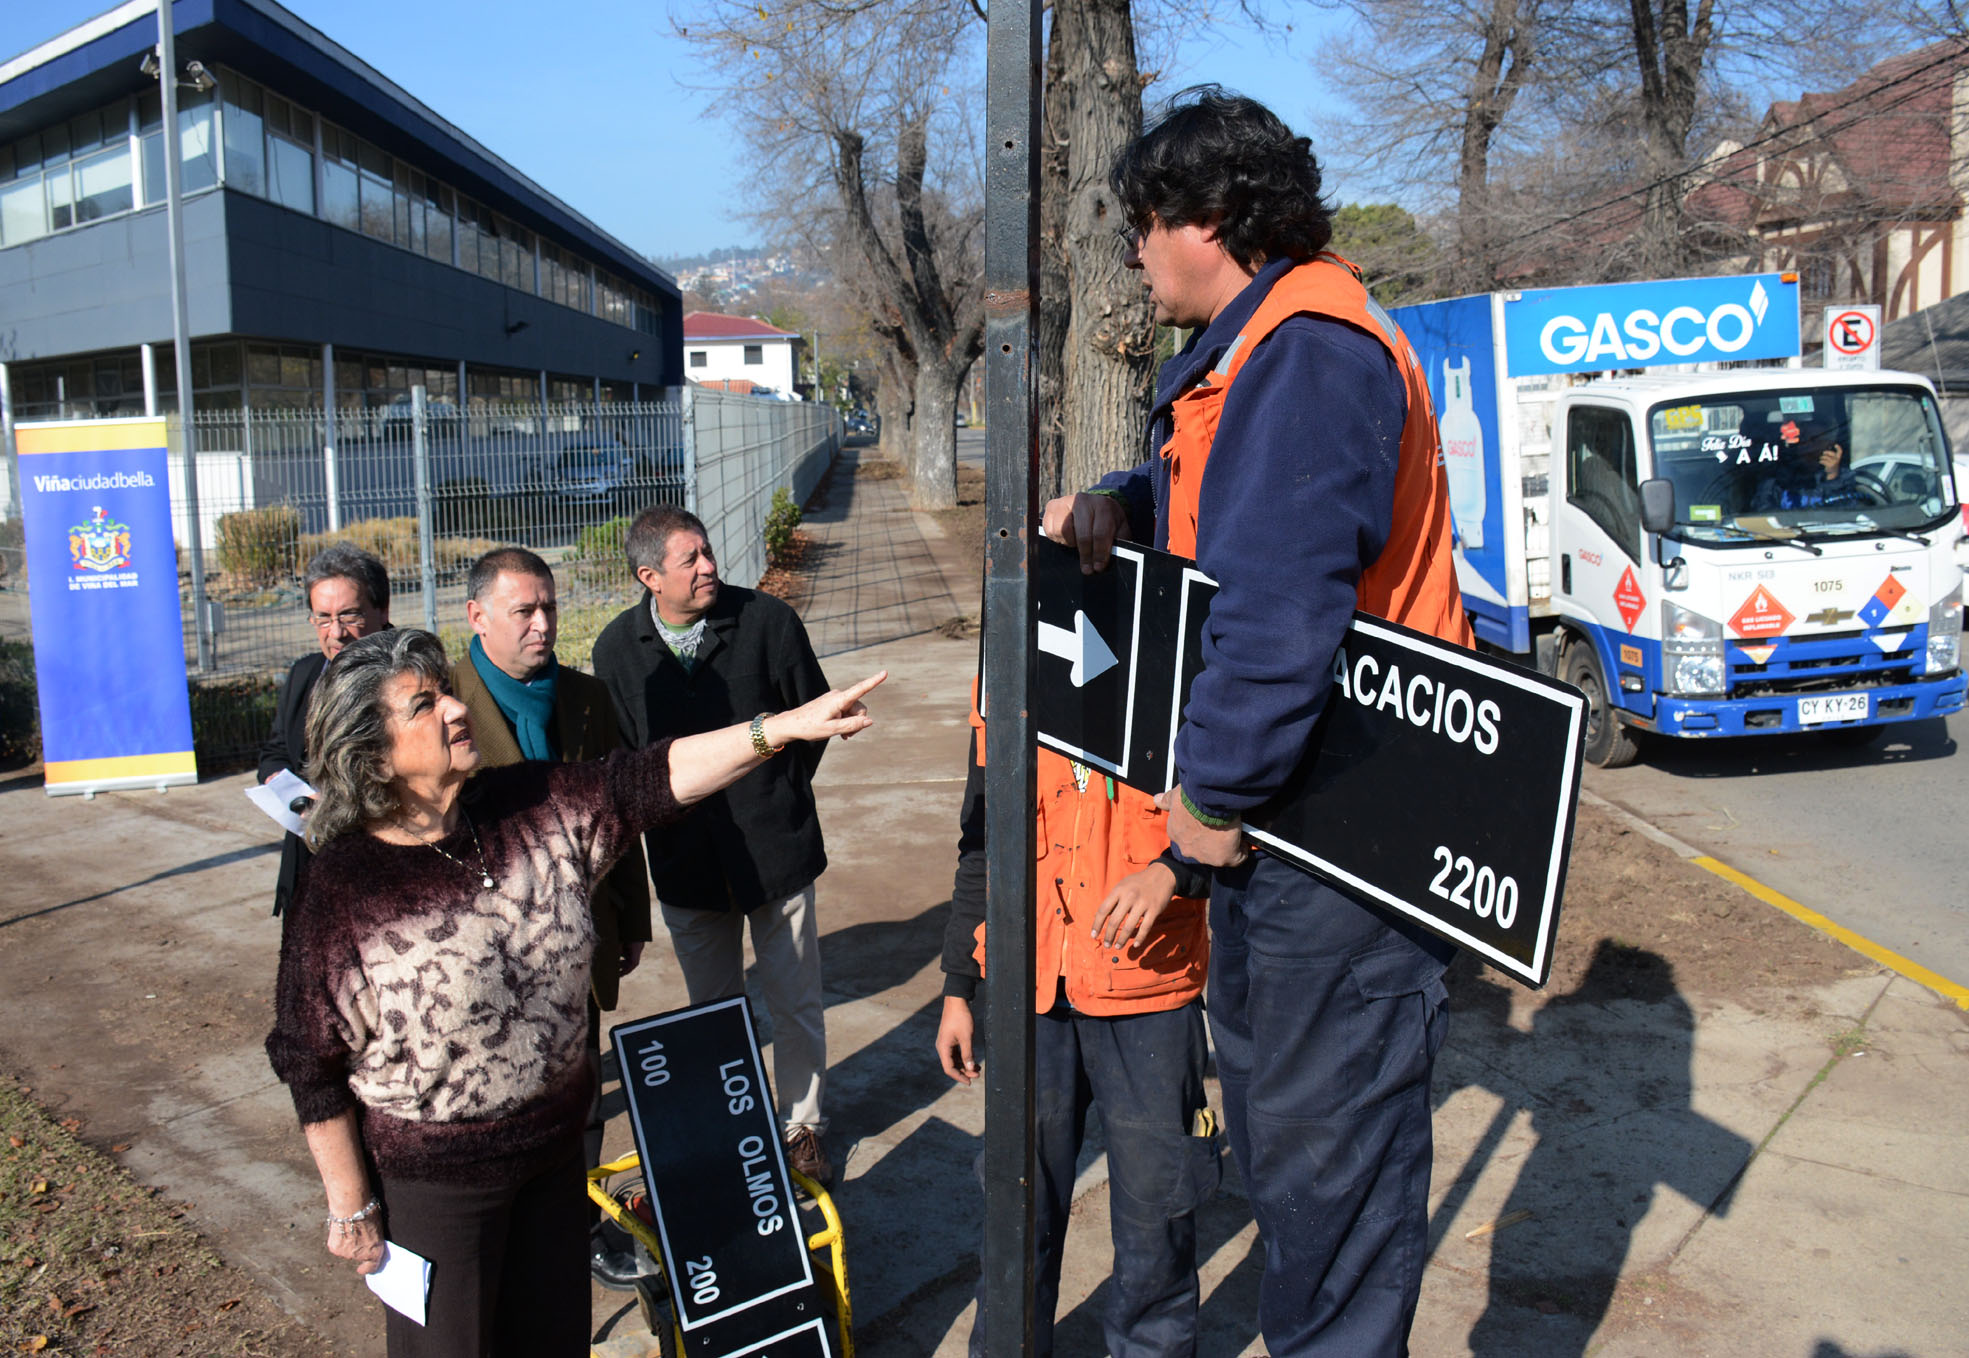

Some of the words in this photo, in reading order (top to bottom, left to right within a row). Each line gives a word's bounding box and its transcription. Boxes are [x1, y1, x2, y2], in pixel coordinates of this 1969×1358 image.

[1540, 303, 1754, 365] GASCO
[1447, 439, 1475, 458] GASCO
[1578, 548, 1602, 567] GASCO
[69, 582, 81, 591] DE
[102, 580, 119, 589] DEL
[119, 579, 139, 588] MAR
[75, 572, 138, 583] MUNICIPALIDAD
[1728, 571, 1753, 581] NKR
[1814, 580, 1843, 593] 1075
[1333, 647, 1501, 755] ACACIOS
[1801, 700, 1819, 716] CY
[1429, 845, 1519, 929] 2200
[719, 1059, 754, 1115] LOS
[738, 1135, 784, 1236] OLMOS
[638, 1040, 671, 1087] 100
[686, 1255, 720, 1305] 200
